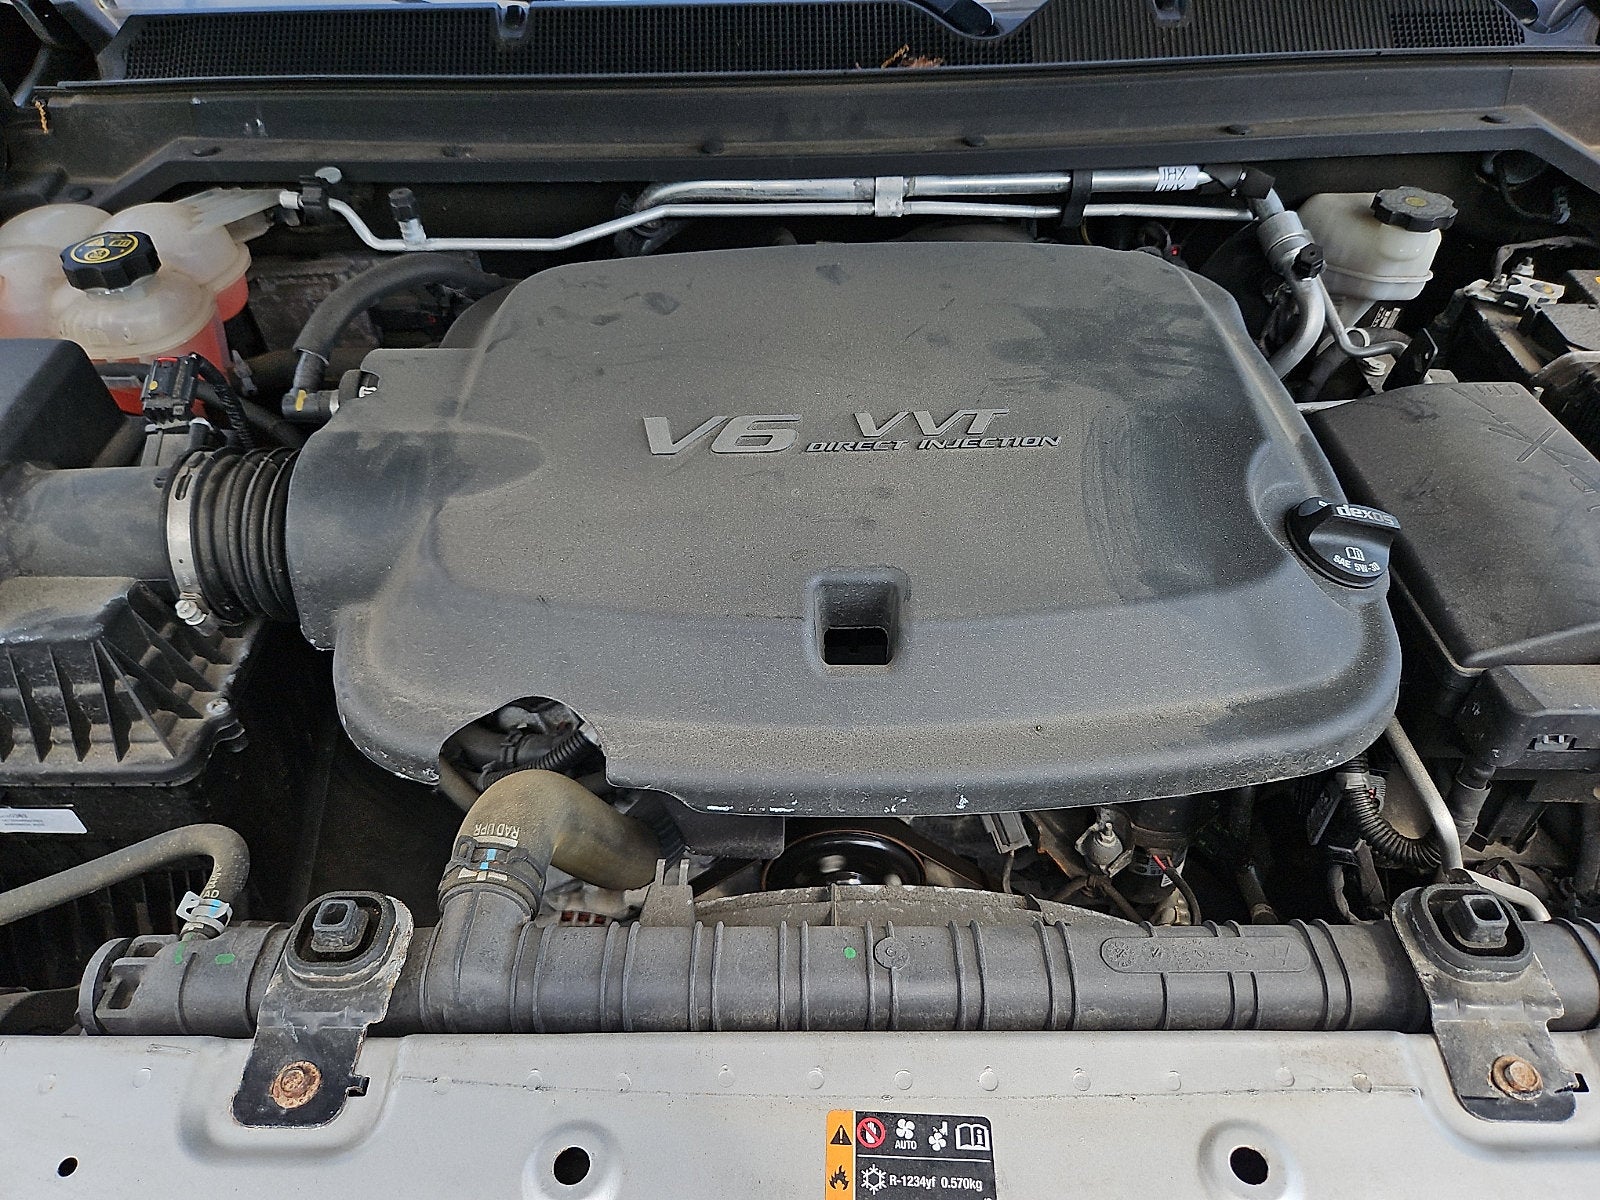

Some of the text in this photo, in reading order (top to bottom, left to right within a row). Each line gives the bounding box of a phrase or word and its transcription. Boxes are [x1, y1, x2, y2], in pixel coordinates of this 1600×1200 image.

[854, 408, 1010, 438] VVT
[643, 414, 800, 455] V6
[806, 436, 1062, 452] DIRECT INJECTION
[1336, 504, 1395, 526] dexos
[1333, 555, 1381, 573] SAE 5W-30
[473, 823, 520, 840] RAD UPR
[894, 1140, 917, 1150] AUTO
[889, 1175, 983, 1192] R-1234yf 0.570kg
